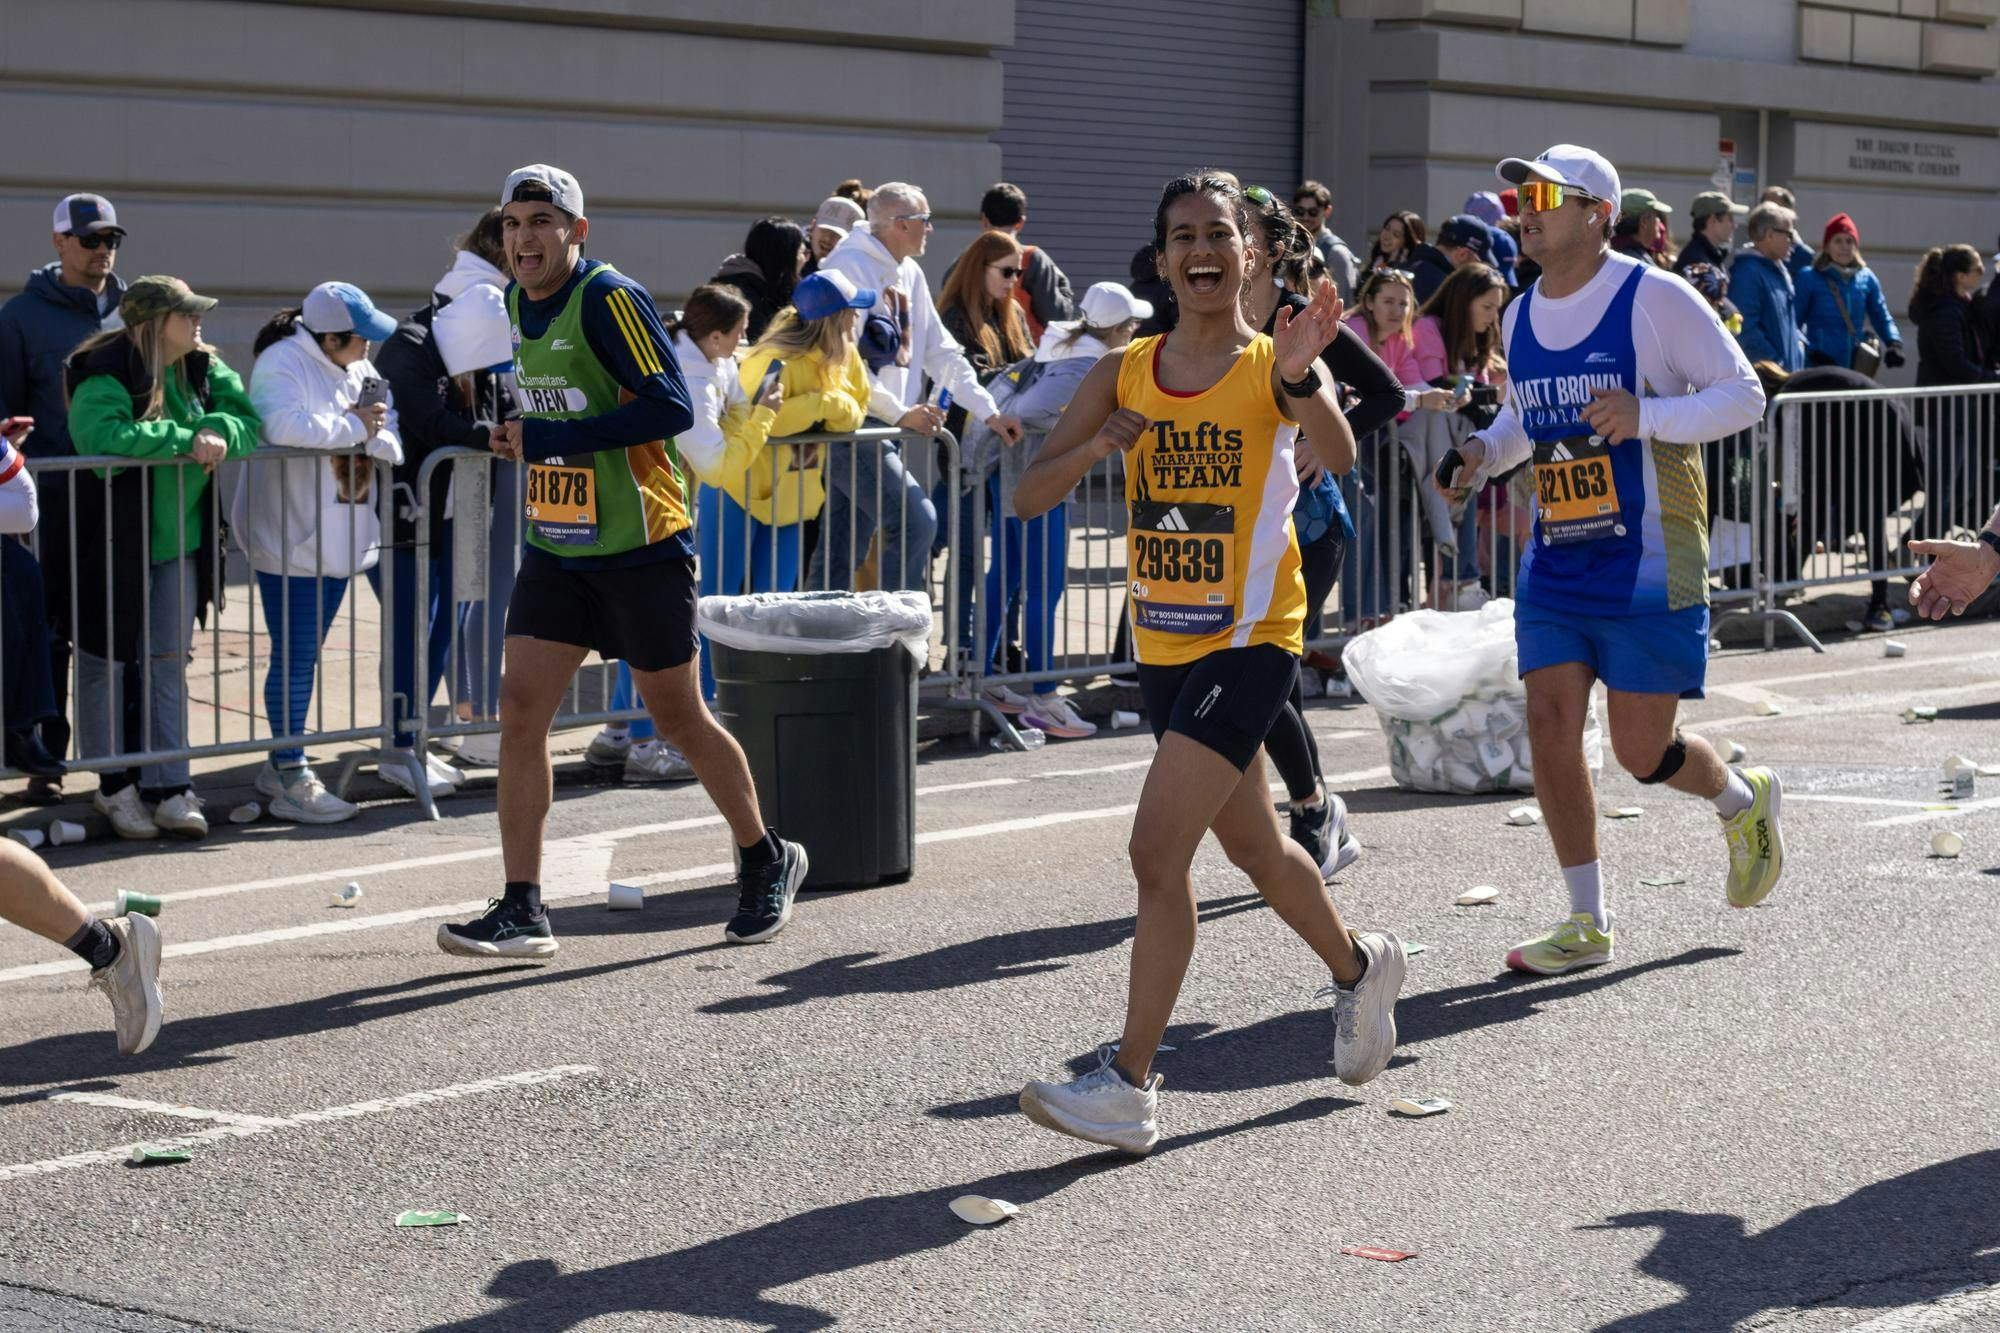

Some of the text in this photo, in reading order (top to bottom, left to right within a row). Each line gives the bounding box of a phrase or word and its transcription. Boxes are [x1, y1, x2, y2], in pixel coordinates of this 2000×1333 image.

[525, 374, 568, 387] samaritans
[1149, 420, 1243, 454] Tufts
[1151, 452, 1243, 467] MARATHON
[529, 468, 588, 507] 31878
[1153, 465, 1243, 490] TEAM
[1538, 461, 1608, 505] 32163
[1135, 534, 1224, 584] 29339
[1132, 583, 1139, 595] 4
[1158, 611, 1184, 620] BOSTON
[1184, 612, 1223, 622] MARATHON
[1757, 818, 1770, 859] HOKA
